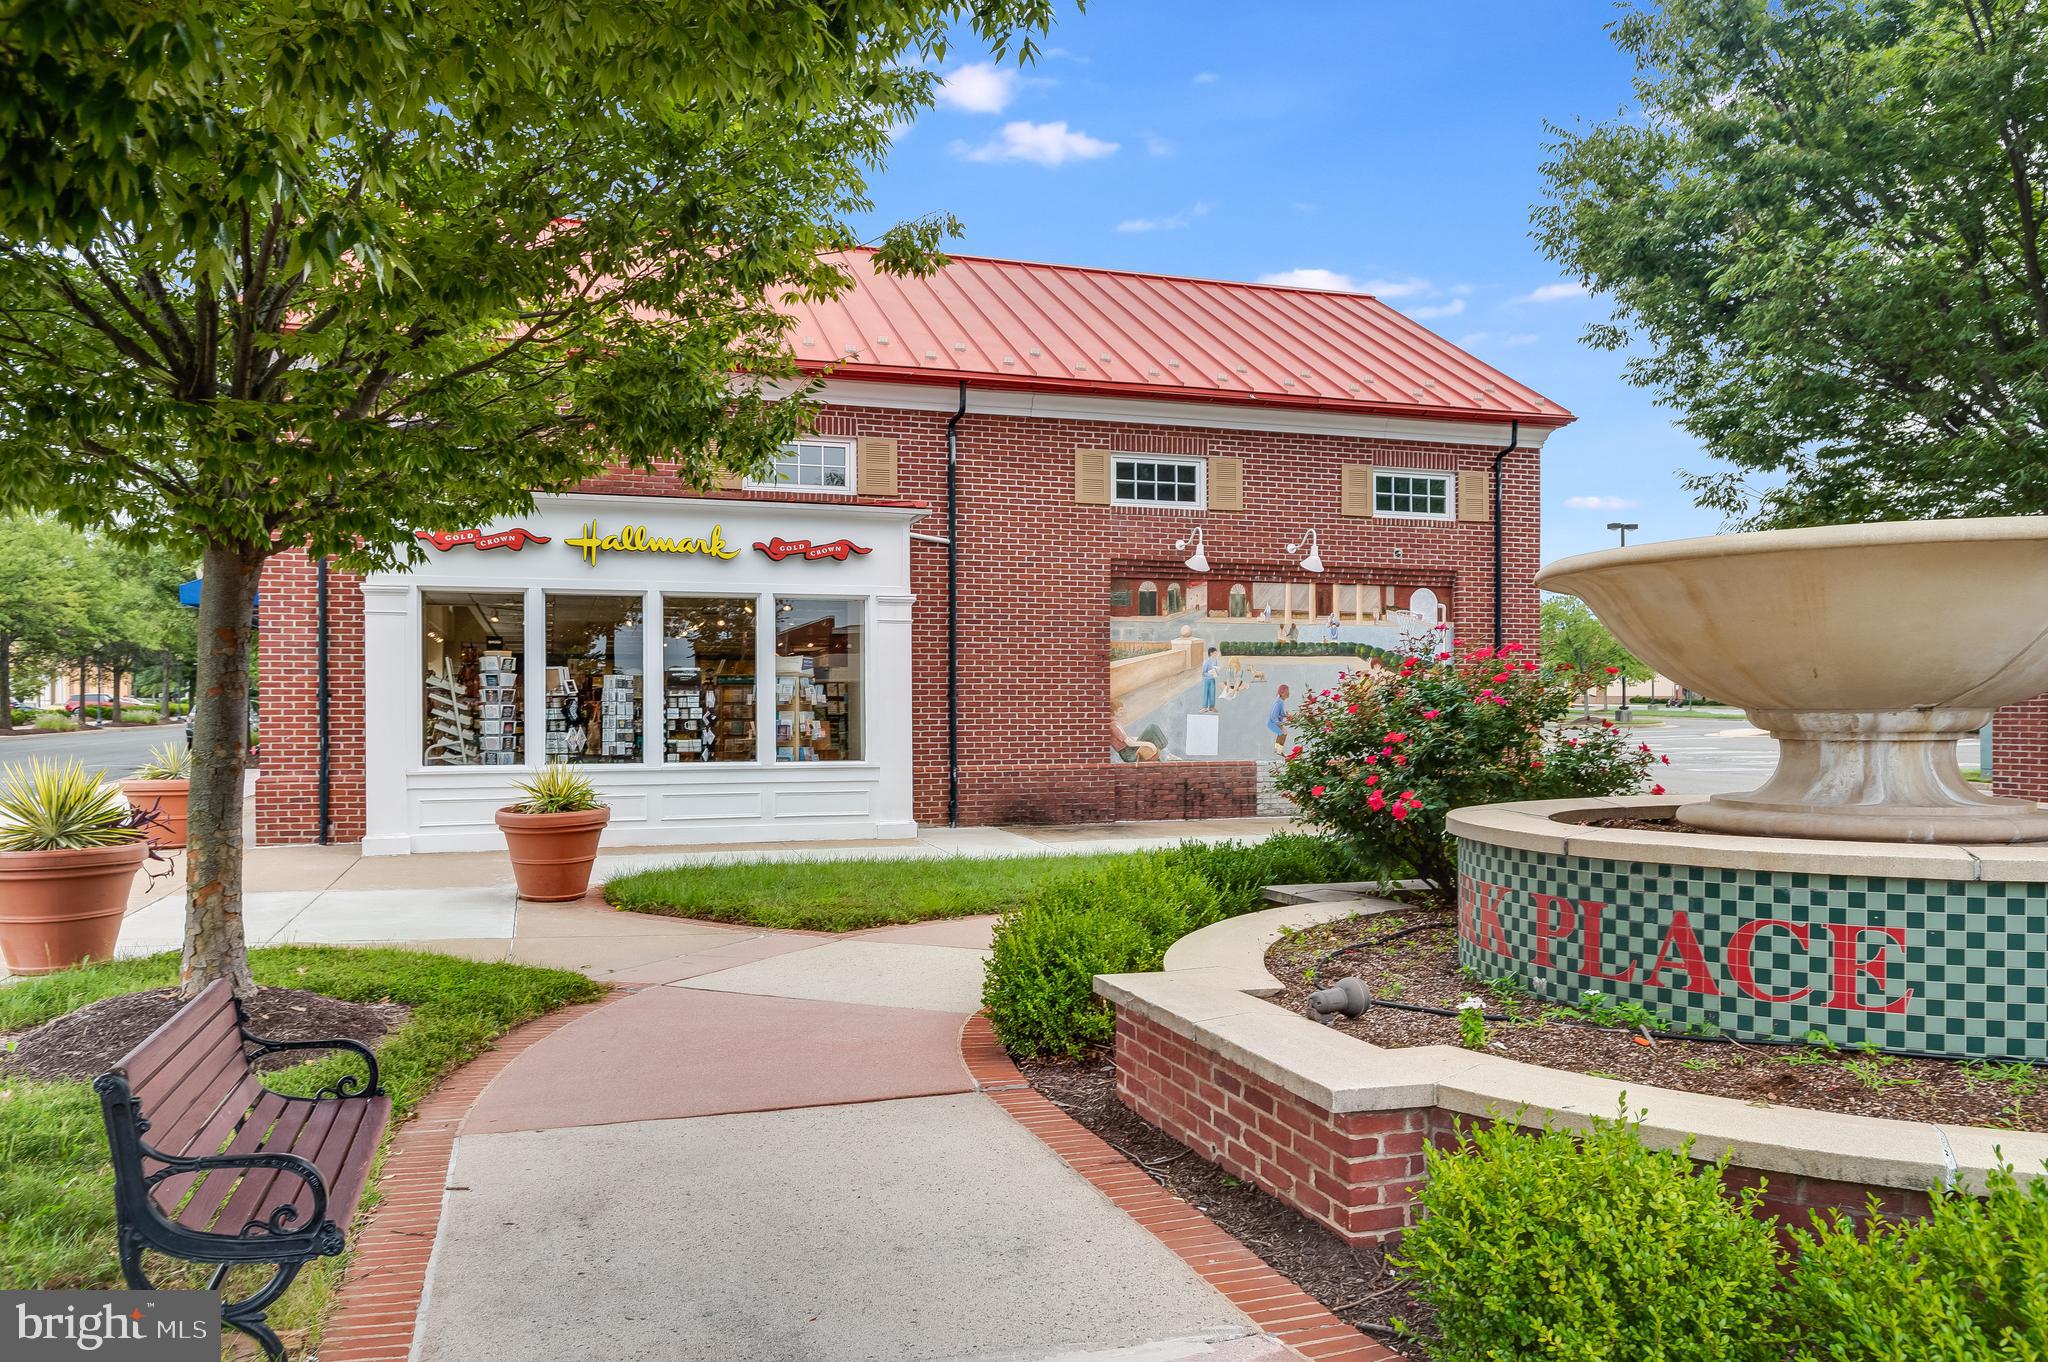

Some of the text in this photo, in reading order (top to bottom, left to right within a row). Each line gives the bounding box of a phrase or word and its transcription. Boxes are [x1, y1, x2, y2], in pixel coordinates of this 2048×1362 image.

[444, 533, 516, 547] GOLD CROWN
[564, 518, 742, 567] Hallmark
[810, 546, 841, 556] CROWN
[1458, 872, 1914, 1014] RK PLACE
